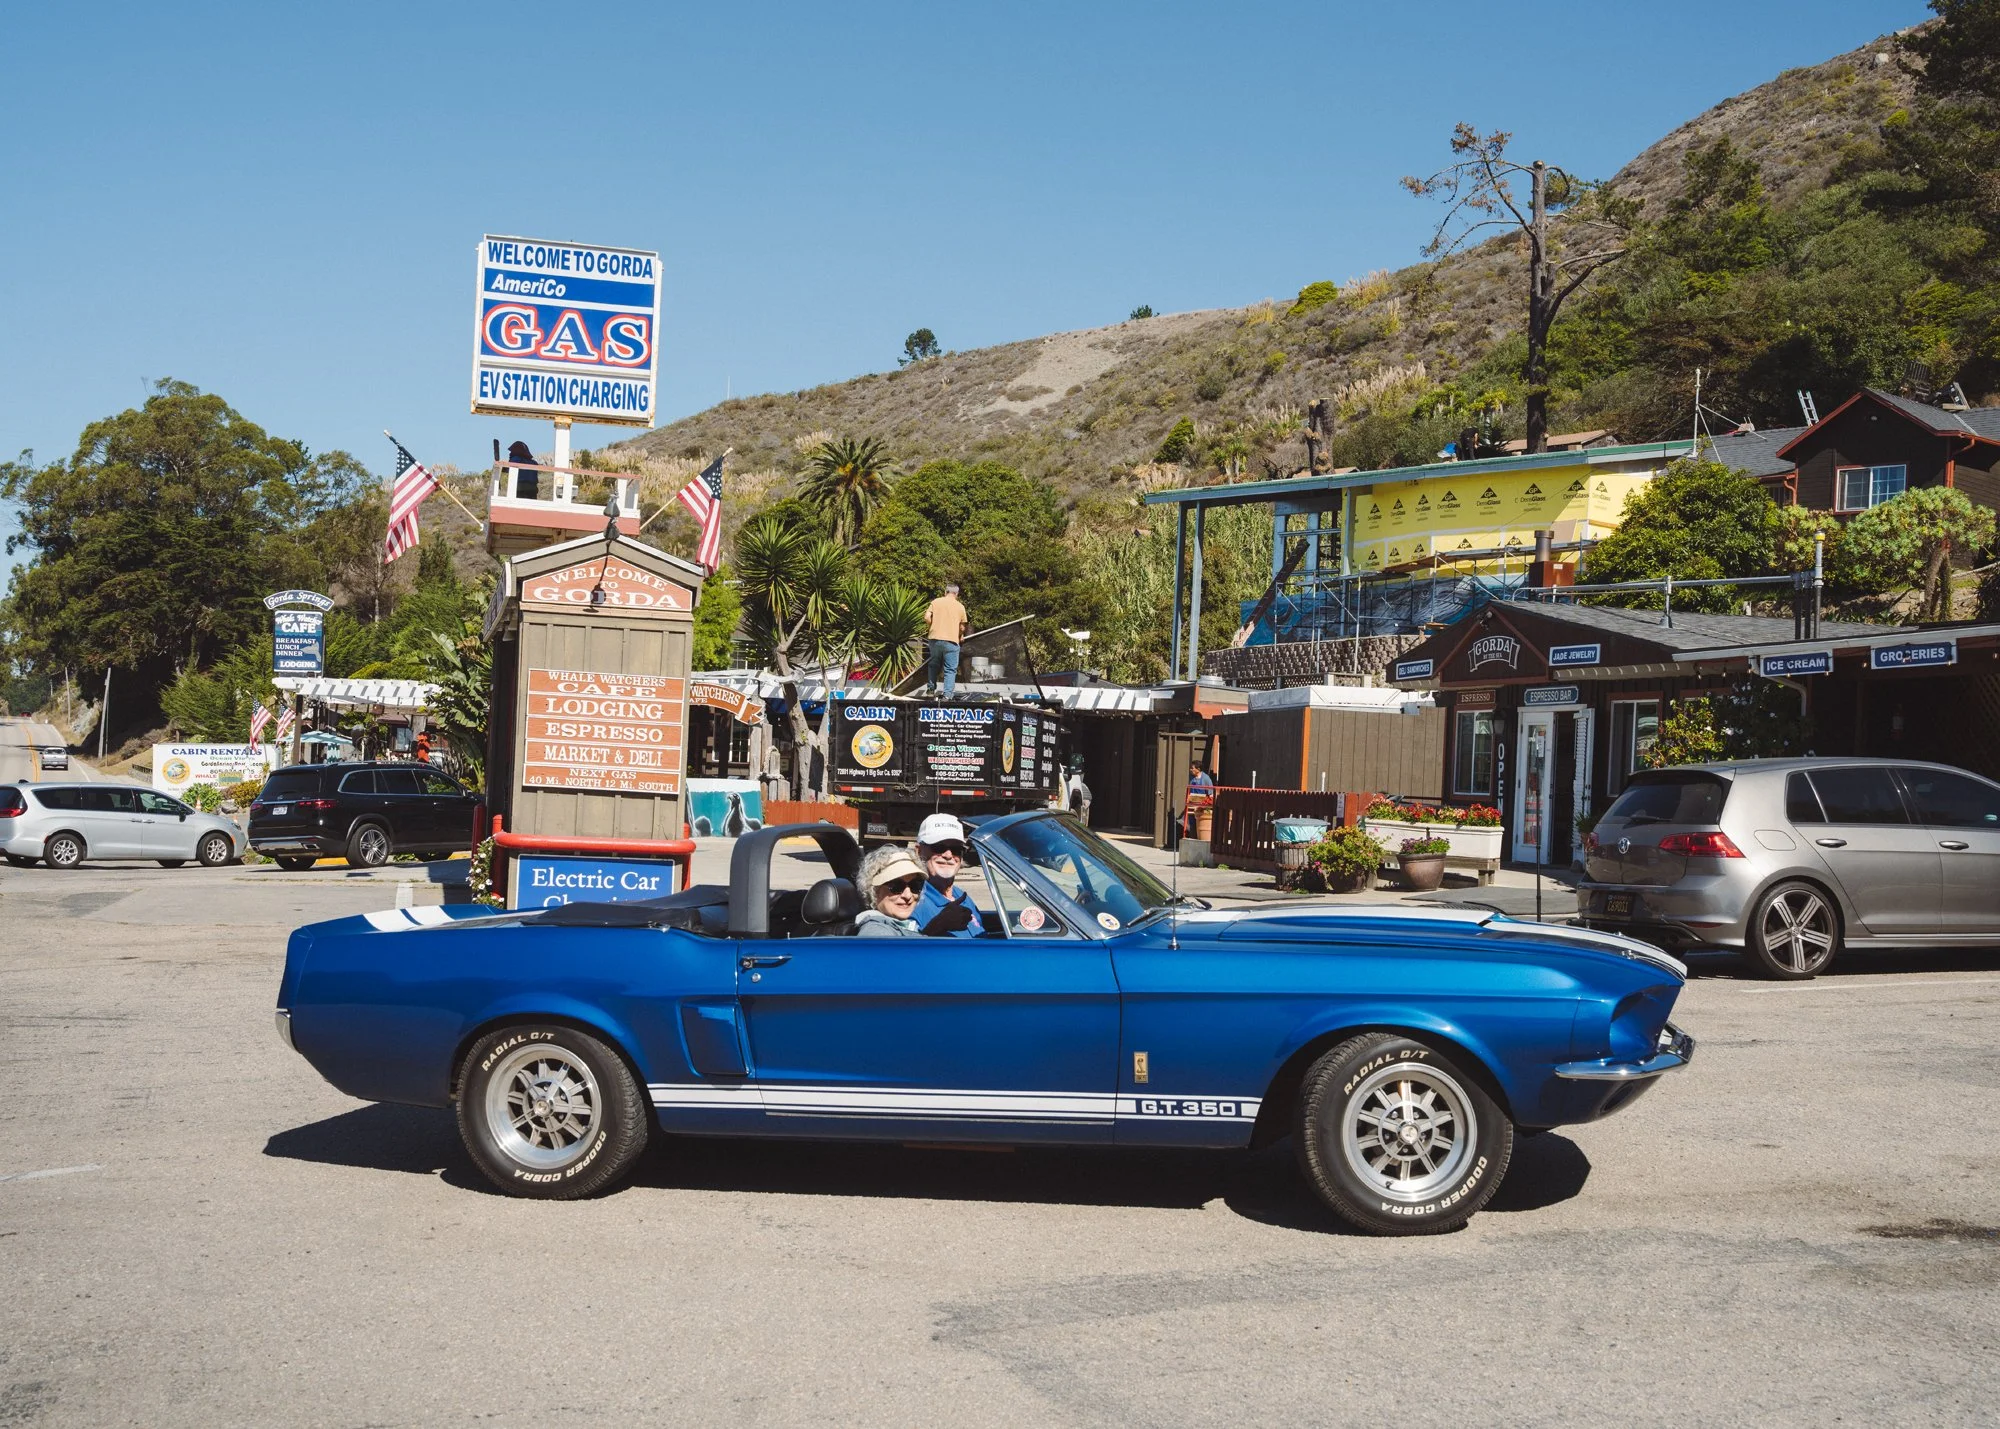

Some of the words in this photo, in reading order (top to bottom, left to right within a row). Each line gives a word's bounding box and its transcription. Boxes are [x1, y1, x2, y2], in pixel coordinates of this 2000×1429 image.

[488, 241, 570, 271] WELCOME
[573, 250, 595, 274] TO
[597, 252, 653, 279] GORDA
[491, 273, 566, 297] AmeriCo
[483, 304, 651, 367] GAS
[480, 370, 500, 399] EV
[501, 373, 567, 406] STATION
[570, 378, 649, 412] CHARGING
[551, 566, 668, 591] WELCOME
[600, 581, 619, 589] TO
[268, 592, 294, 607] Gorda
[297, 592, 331, 607] Springs
[534, 587, 681, 609] GORDA
[1475, 638, 1510, 656] GORDA
[1553, 652, 1567, 661] JADE
[1568, 650, 1595, 660] JEWELRY
[1766, 661, 1784, 672] ICE
[1786, 658, 1825, 670] CREAM
[548, 671, 595, 683] WHALE
[600, 674, 666, 687] WATCHERS
[557, 682, 656, 698] CAFE
[690, 686, 741, 706] WATCHERS
[1461, 694, 1490, 703] ESPRESSO
[1530, 690, 1558, 702] ESPRESSO
[1559, 690, 1572, 701] BAR
[546, 697, 664, 720] LODGING
[845, 706, 896, 721] CABIN
[919, 708, 995, 723] RENTALS
[545, 722, 663, 743] ESPRESSO
[544, 745, 610, 764] MARKET
[614, 750, 624, 764] &
[629, 749, 663, 767] DELI
[957, 744, 985, 752] Views
[529, 775, 542, 784] 40
[546, 776, 562, 785] Mi.
[565, 778, 601, 788] NORTH
[605, 779, 616, 787] 12
[620, 781, 635, 789] Mi.
[638, 782, 674, 791] SOUTH
[569, 768, 608, 778] NEXT
[611, 770, 637, 780] GAS
[532, 867, 615, 889] Electric
[620, 871, 660, 890] Car
[481, 1035, 527, 1072] RADIAL
[1343, 1053, 1395, 1096] RADIAL
[566, 1130, 607, 1178] COOPER
[514, 1168, 562, 1183] COBRA
[1440, 1155, 1488, 1209] COOPER
[1381, 1202, 1436, 1215] COBRA
